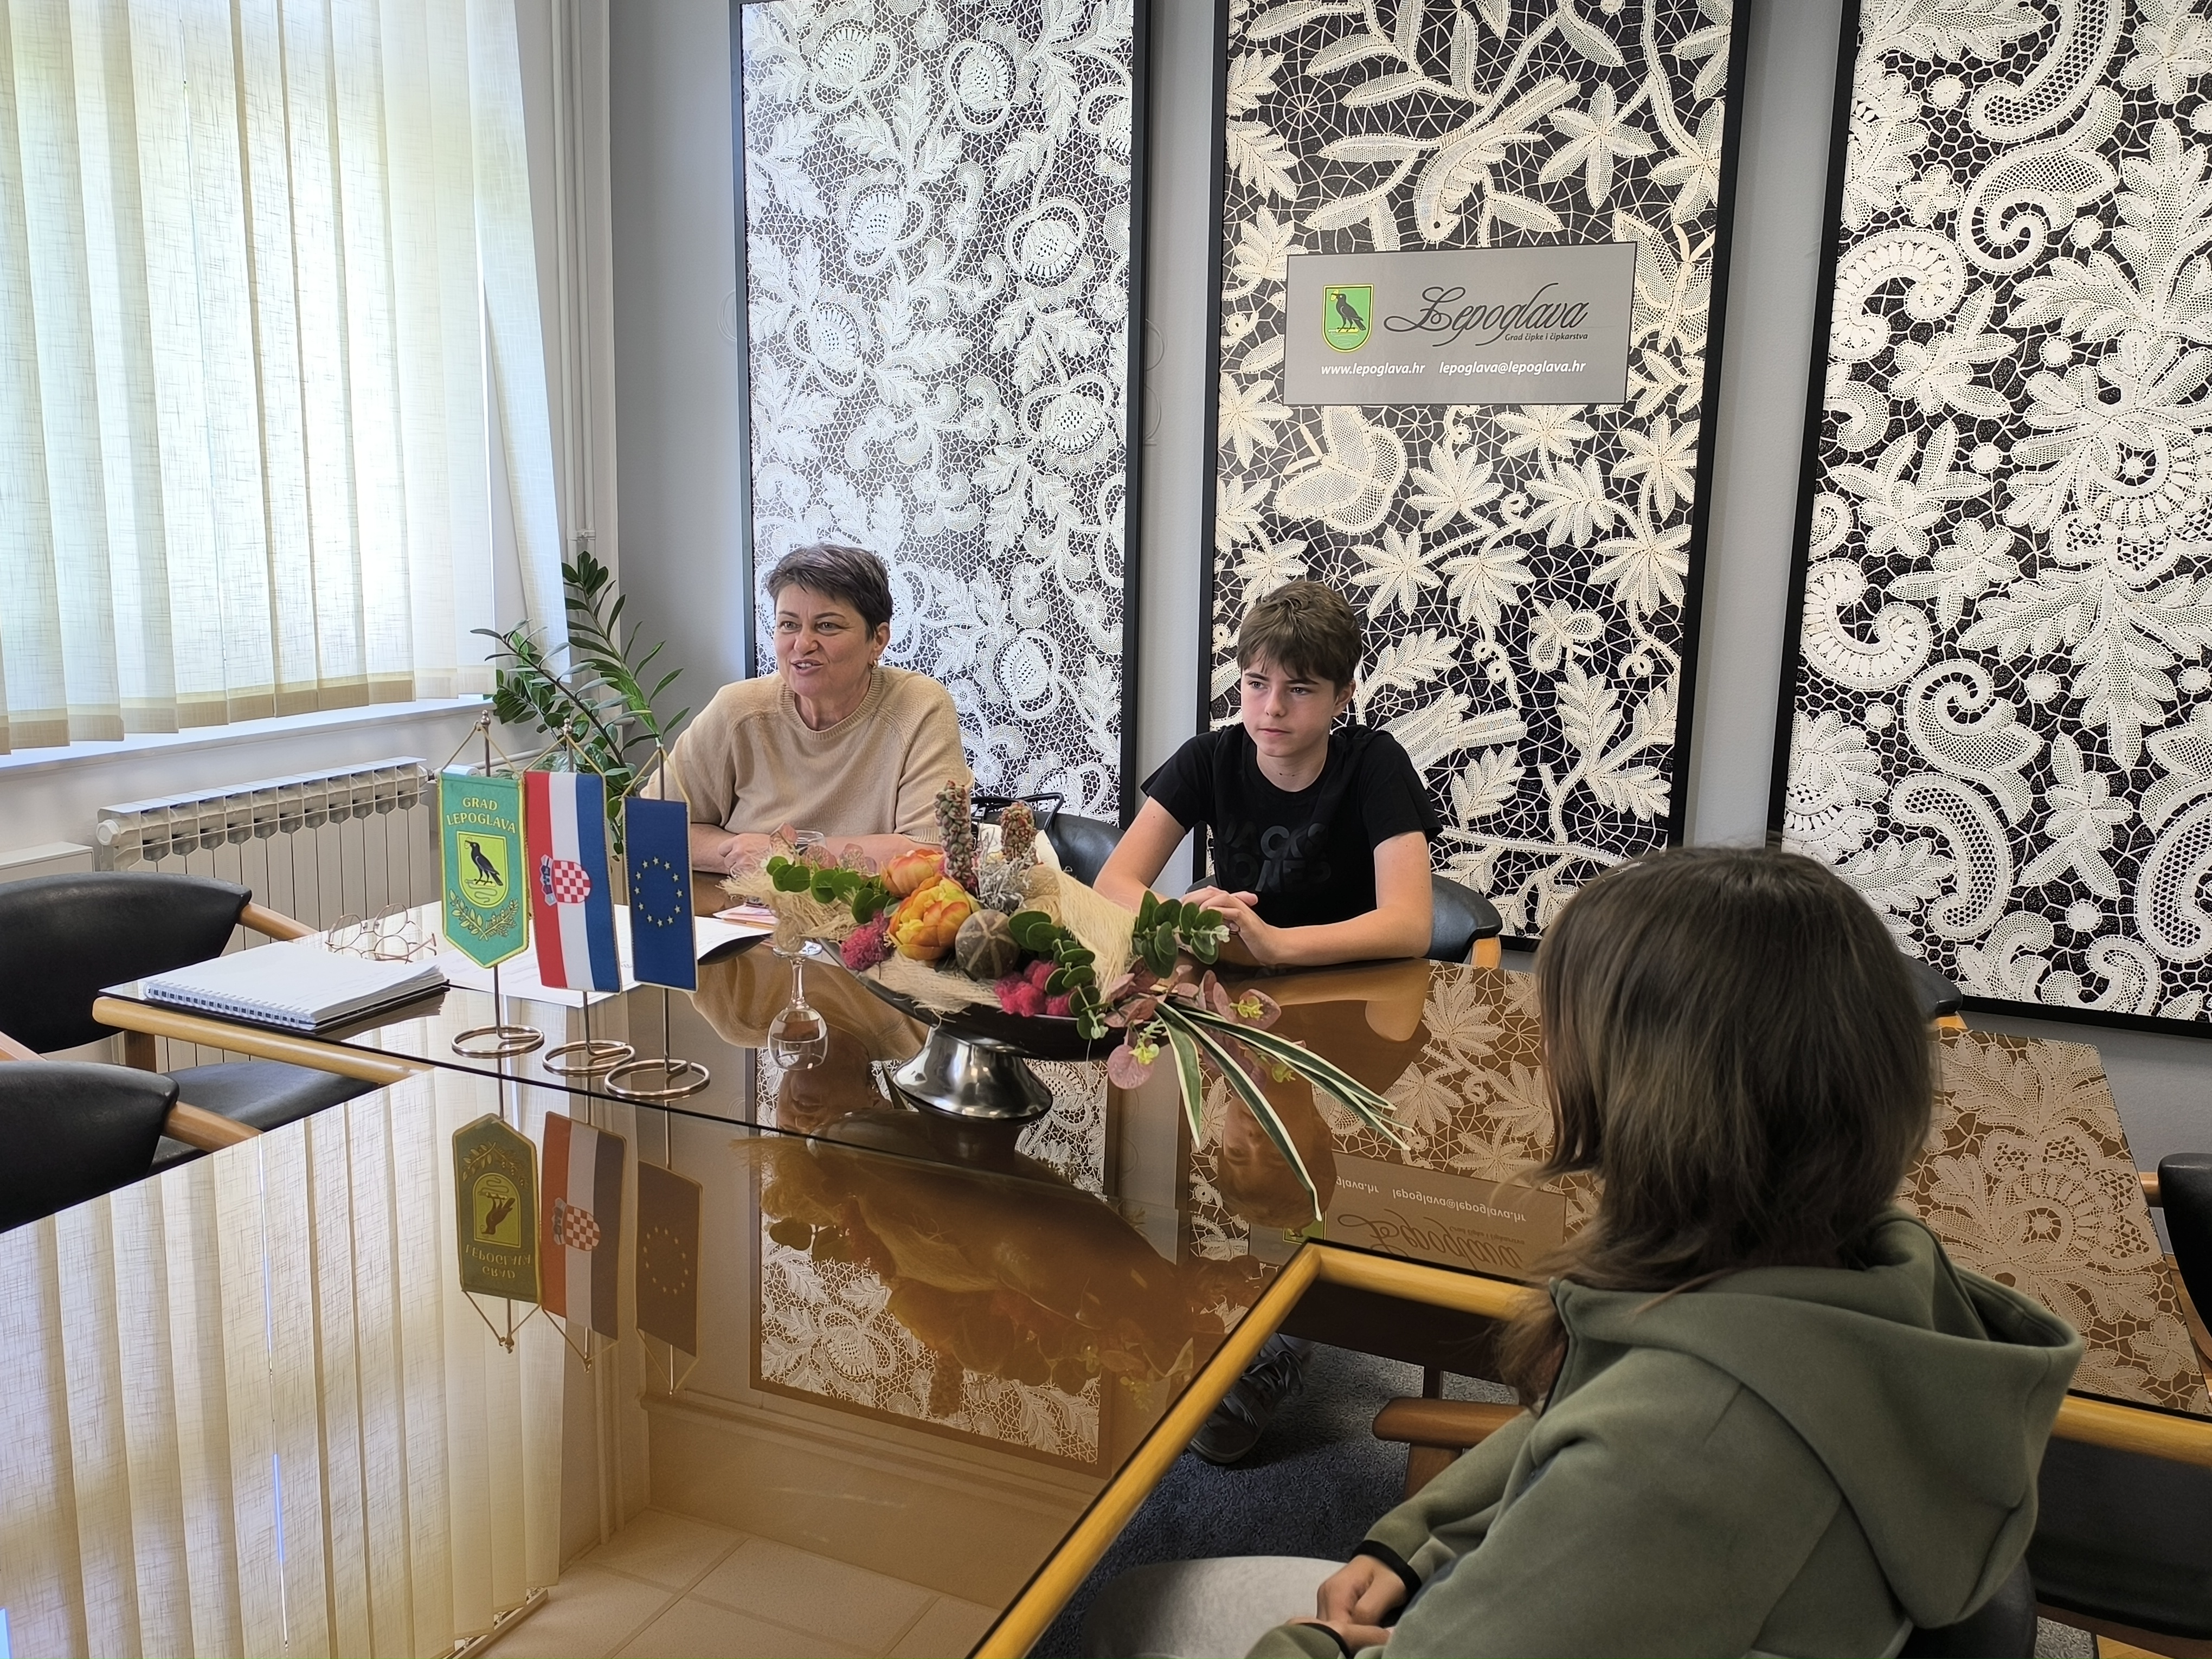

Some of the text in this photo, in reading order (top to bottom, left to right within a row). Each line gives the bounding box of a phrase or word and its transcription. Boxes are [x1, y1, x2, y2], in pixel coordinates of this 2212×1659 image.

[1383, 282, 1590, 347] Lepoglava
[1504, 332, 1588, 342] Grad čipke i čipkarstva
[1321, 359, 1586, 377] www.lepoglava.hr lepoglava@lepoglava.hr
[462, 797, 498, 811] GRAD
[446, 812, 516, 834] LEPOGLAVA
